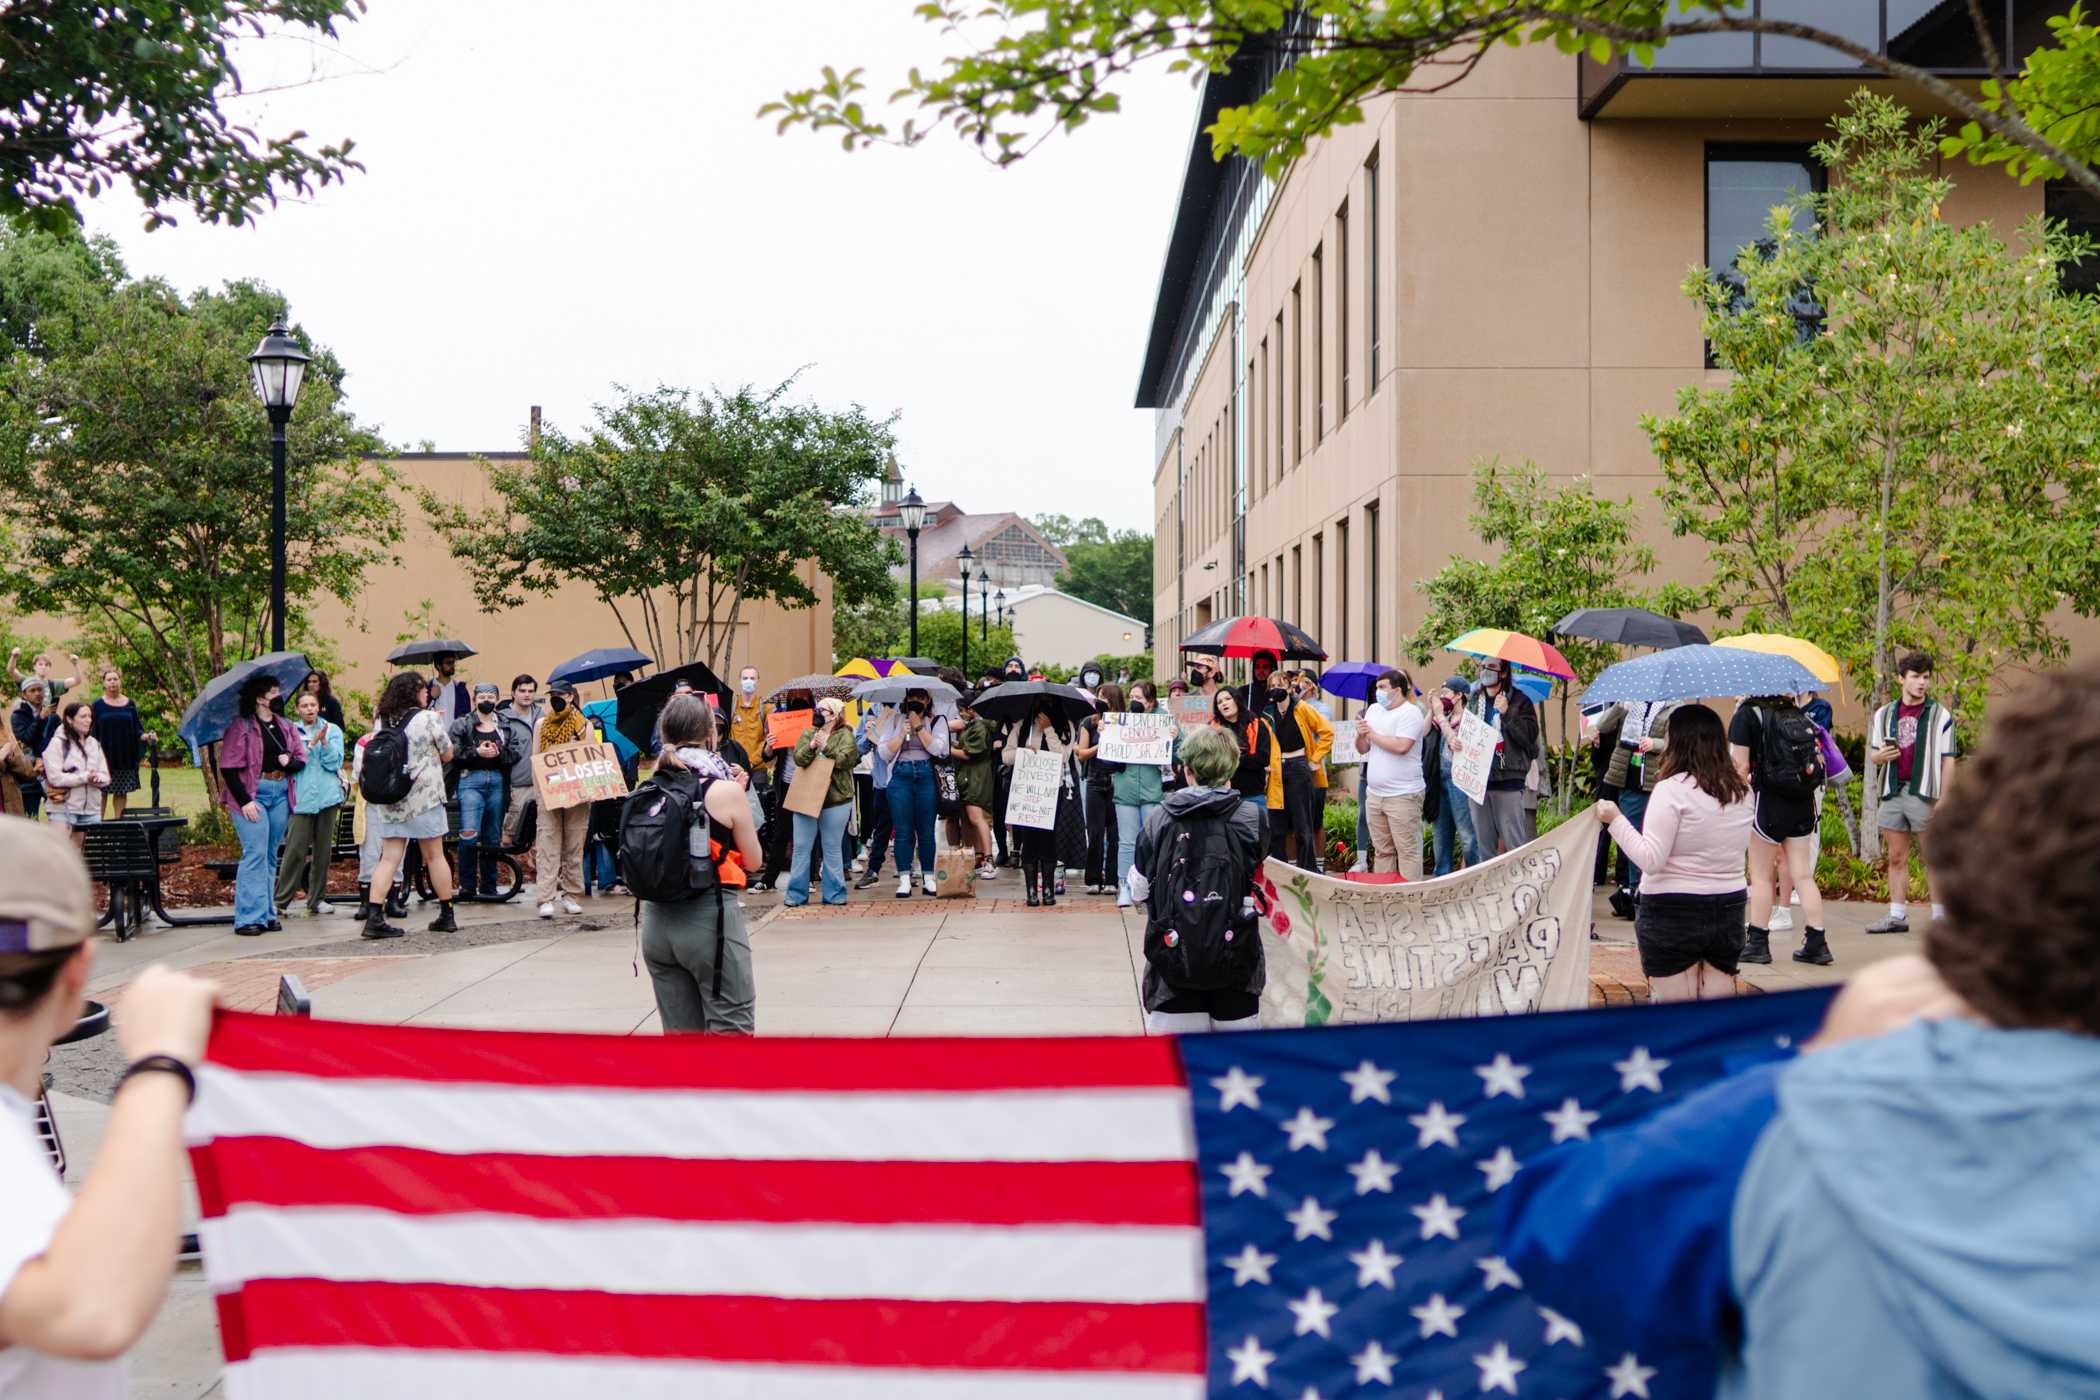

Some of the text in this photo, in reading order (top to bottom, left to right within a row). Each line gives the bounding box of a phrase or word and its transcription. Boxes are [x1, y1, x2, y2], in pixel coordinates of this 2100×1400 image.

[543, 745, 606, 768] GET IN
[562, 760, 616, 781] LOSER
[1018, 769, 1056, 782] DIVEST
